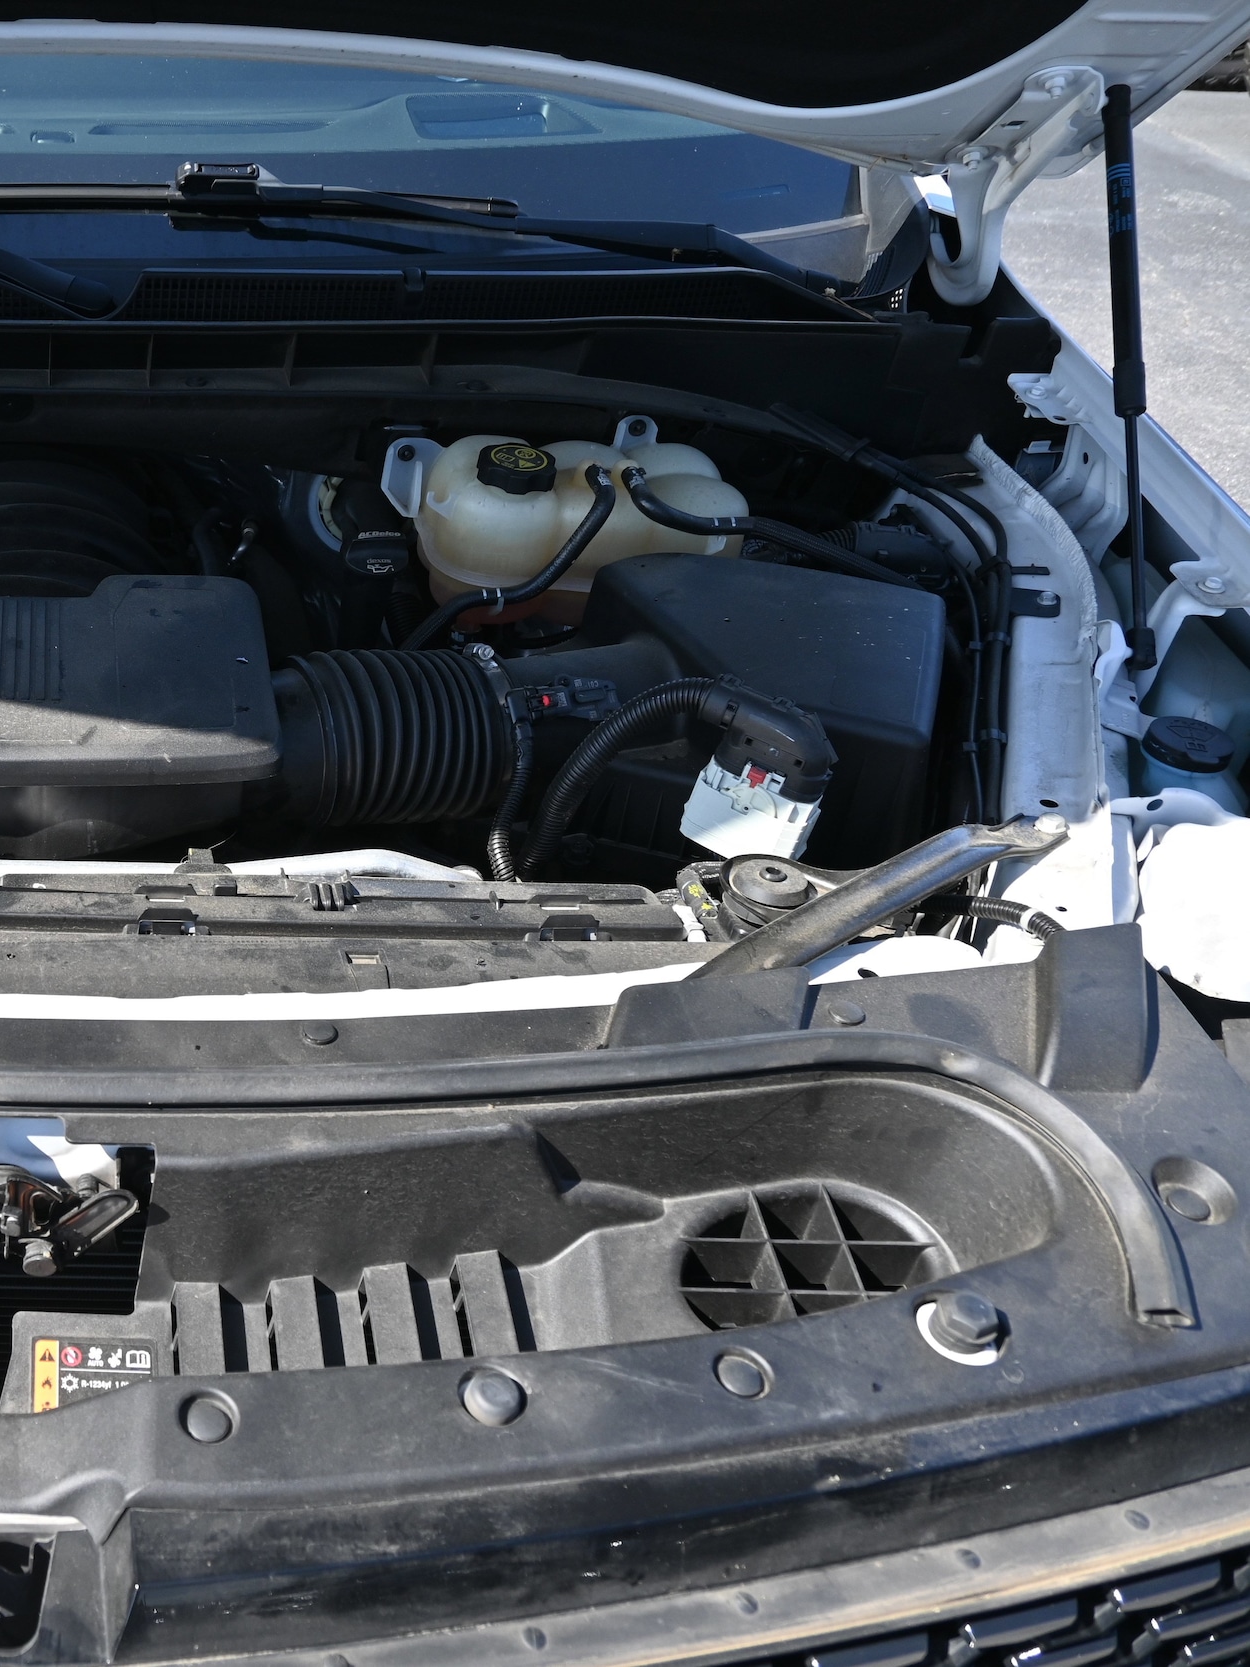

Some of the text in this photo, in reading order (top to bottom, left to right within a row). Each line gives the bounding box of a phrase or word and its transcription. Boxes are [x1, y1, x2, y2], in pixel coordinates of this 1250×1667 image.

[358, 531, 401, 539] ACDelco
[87, 1359, 104, 1367] AUTO
[81, 1379, 112, 1391] R-1234yf
